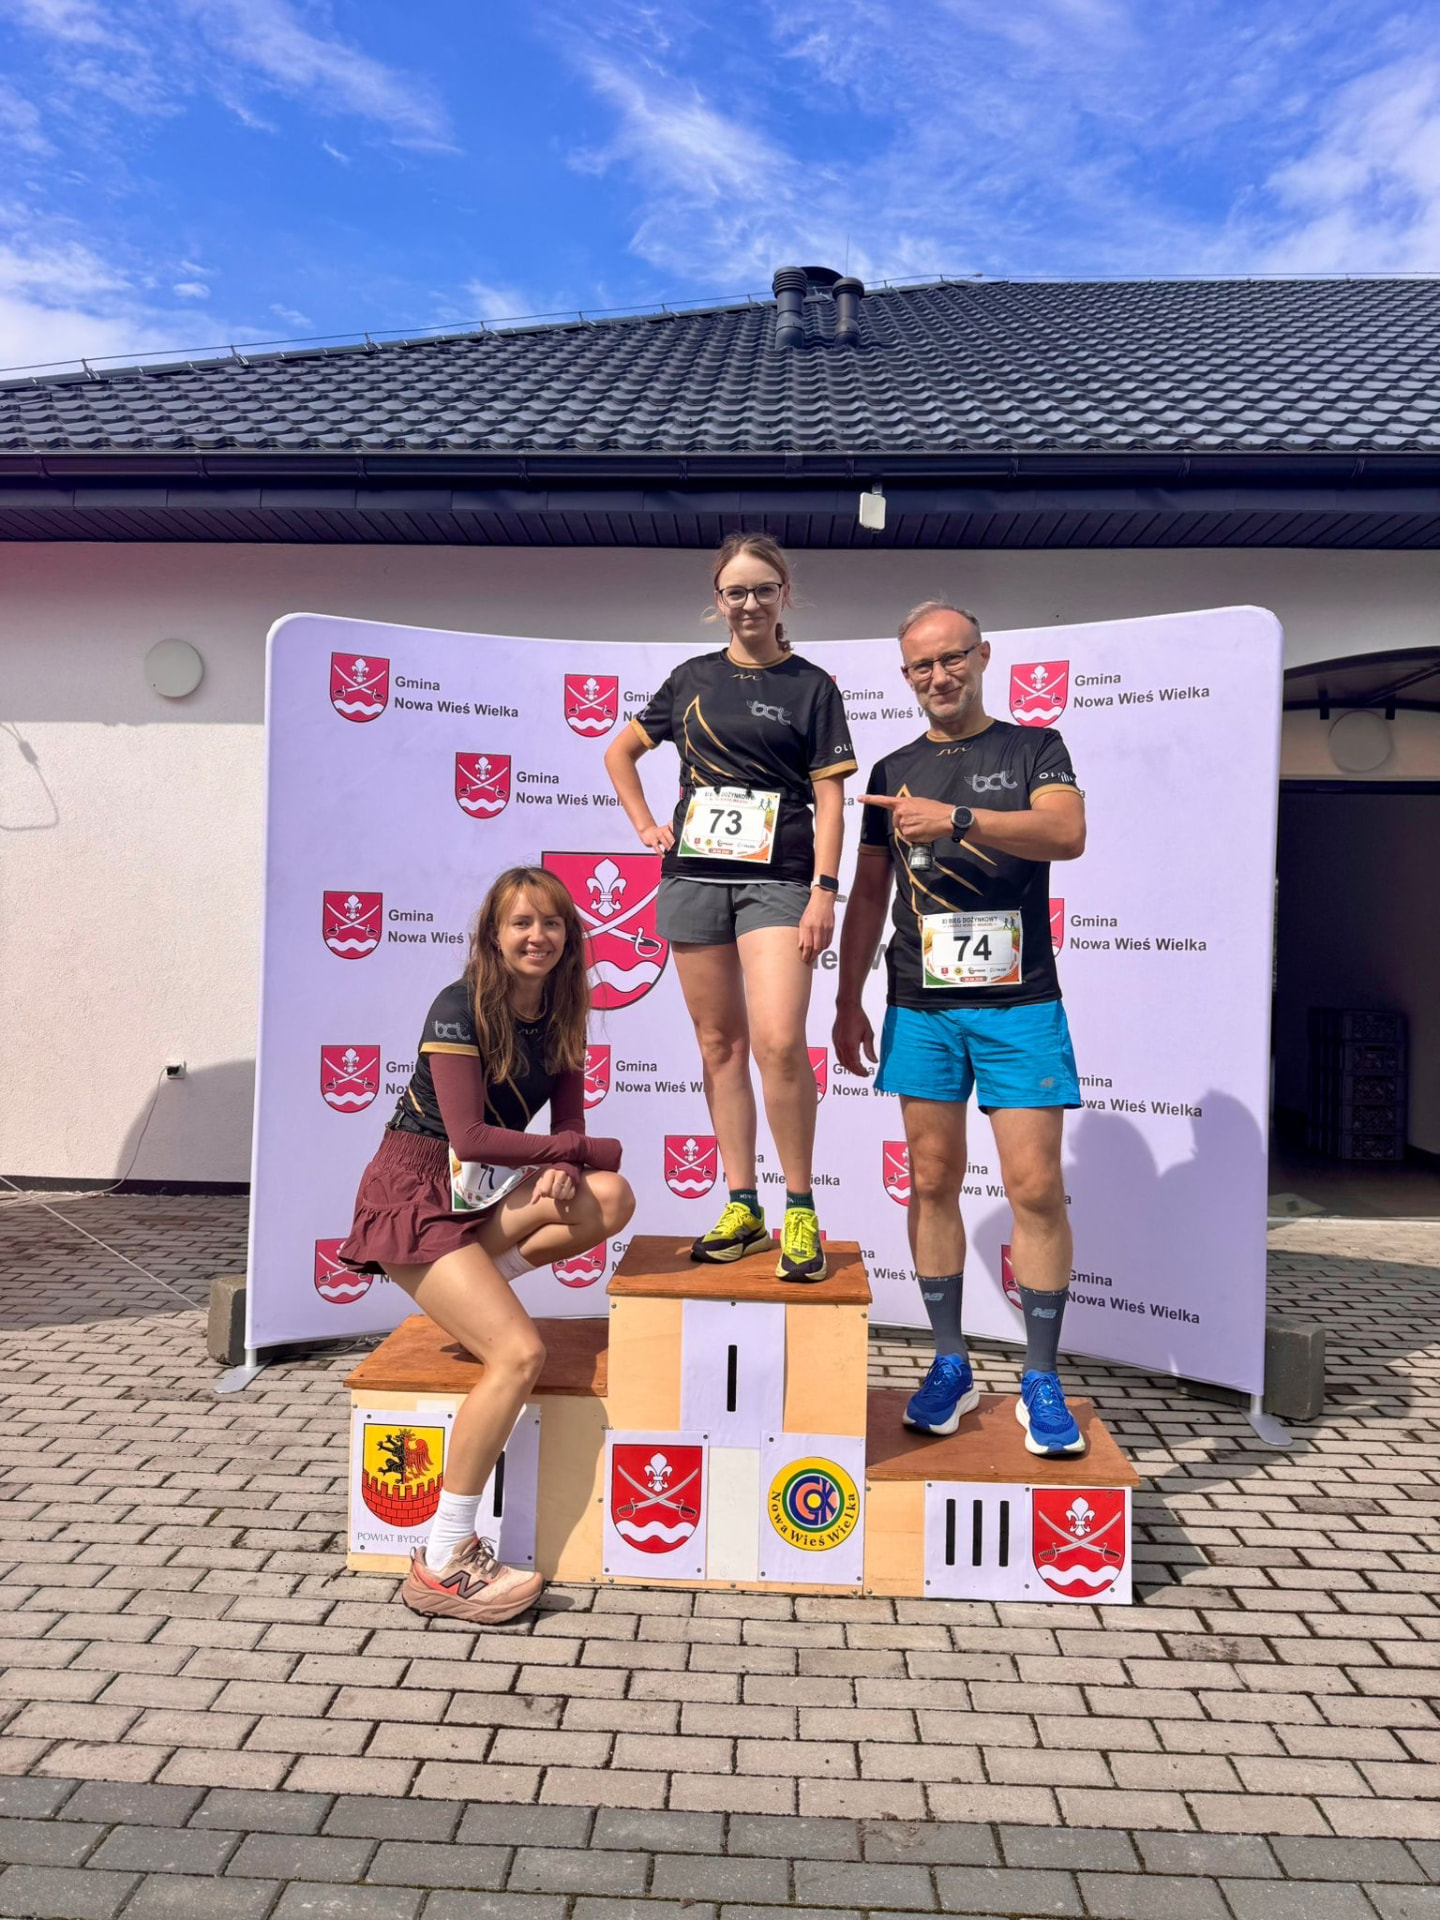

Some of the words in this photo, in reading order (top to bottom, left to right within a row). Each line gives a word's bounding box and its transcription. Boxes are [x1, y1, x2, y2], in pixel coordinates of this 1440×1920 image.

[395, 676, 440, 691] Gmina
[1074, 673, 1121, 687] Gmina
[623, 691, 654, 702] Gmi
[841, 689, 884, 701] Gmina
[1073, 696, 1114, 708] Nowa
[1118, 690, 1154, 705] Wieś
[1159, 686, 1210, 701] Wielka
[394, 697, 433, 711] Nowa
[437, 701, 470, 714] Wieś
[474, 703, 519, 717] Wielka
[881, 707, 914, 719] Wieś
[516, 771, 560, 785] Gmina
[516, 792, 552, 805] Nowa
[556, 793, 589, 805] Wieś
[592, 794, 623, 807] Wiel
[709, 808, 742, 836] 73
[388, 909, 434, 922] Gmina
[1070, 914, 1118, 927] Gmina
[388, 931, 427, 943] Nowa
[431, 931, 464, 944] Wieś
[1070, 937, 1110, 950] Nowa
[1115, 937, 1151, 951] Wieś
[1155, 938, 1207, 951] Wielka
[953, 934, 992, 962] 74
[386, 1061, 414, 1073] Gmi
[616, 1060, 657, 1072] Gmina
[615, 1081, 651, 1092] Nowa
[655, 1081, 686, 1093] Wieś
[1079, 1074, 1113, 1088] mina
[833, 1084, 869, 1096] Nowa
[1110, 1098, 1146, 1113] Wieś
[1151, 1101, 1203, 1117] Wielka
[967, 1162, 988, 1175] ina
[762, 1172, 786, 1184] Wie
[810, 1174, 840, 1186] ielka
[873, 1267, 906, 1281] Wieś
[1068, 1269, 1113, 1287] Gmina
[1067, 1291, 1106, 1307] Nowa
[1110, 1296, 1146, 1314] Wieś
[1150, 1303, 1200, 1324] Wielka
[771, 1490, 788, 1534] Nowa
[790, 1529, 825, 1546] Wieś
[827, 1493, 856, 1543] Wielka
[357, 1532, 394, 1542] POWIAT
